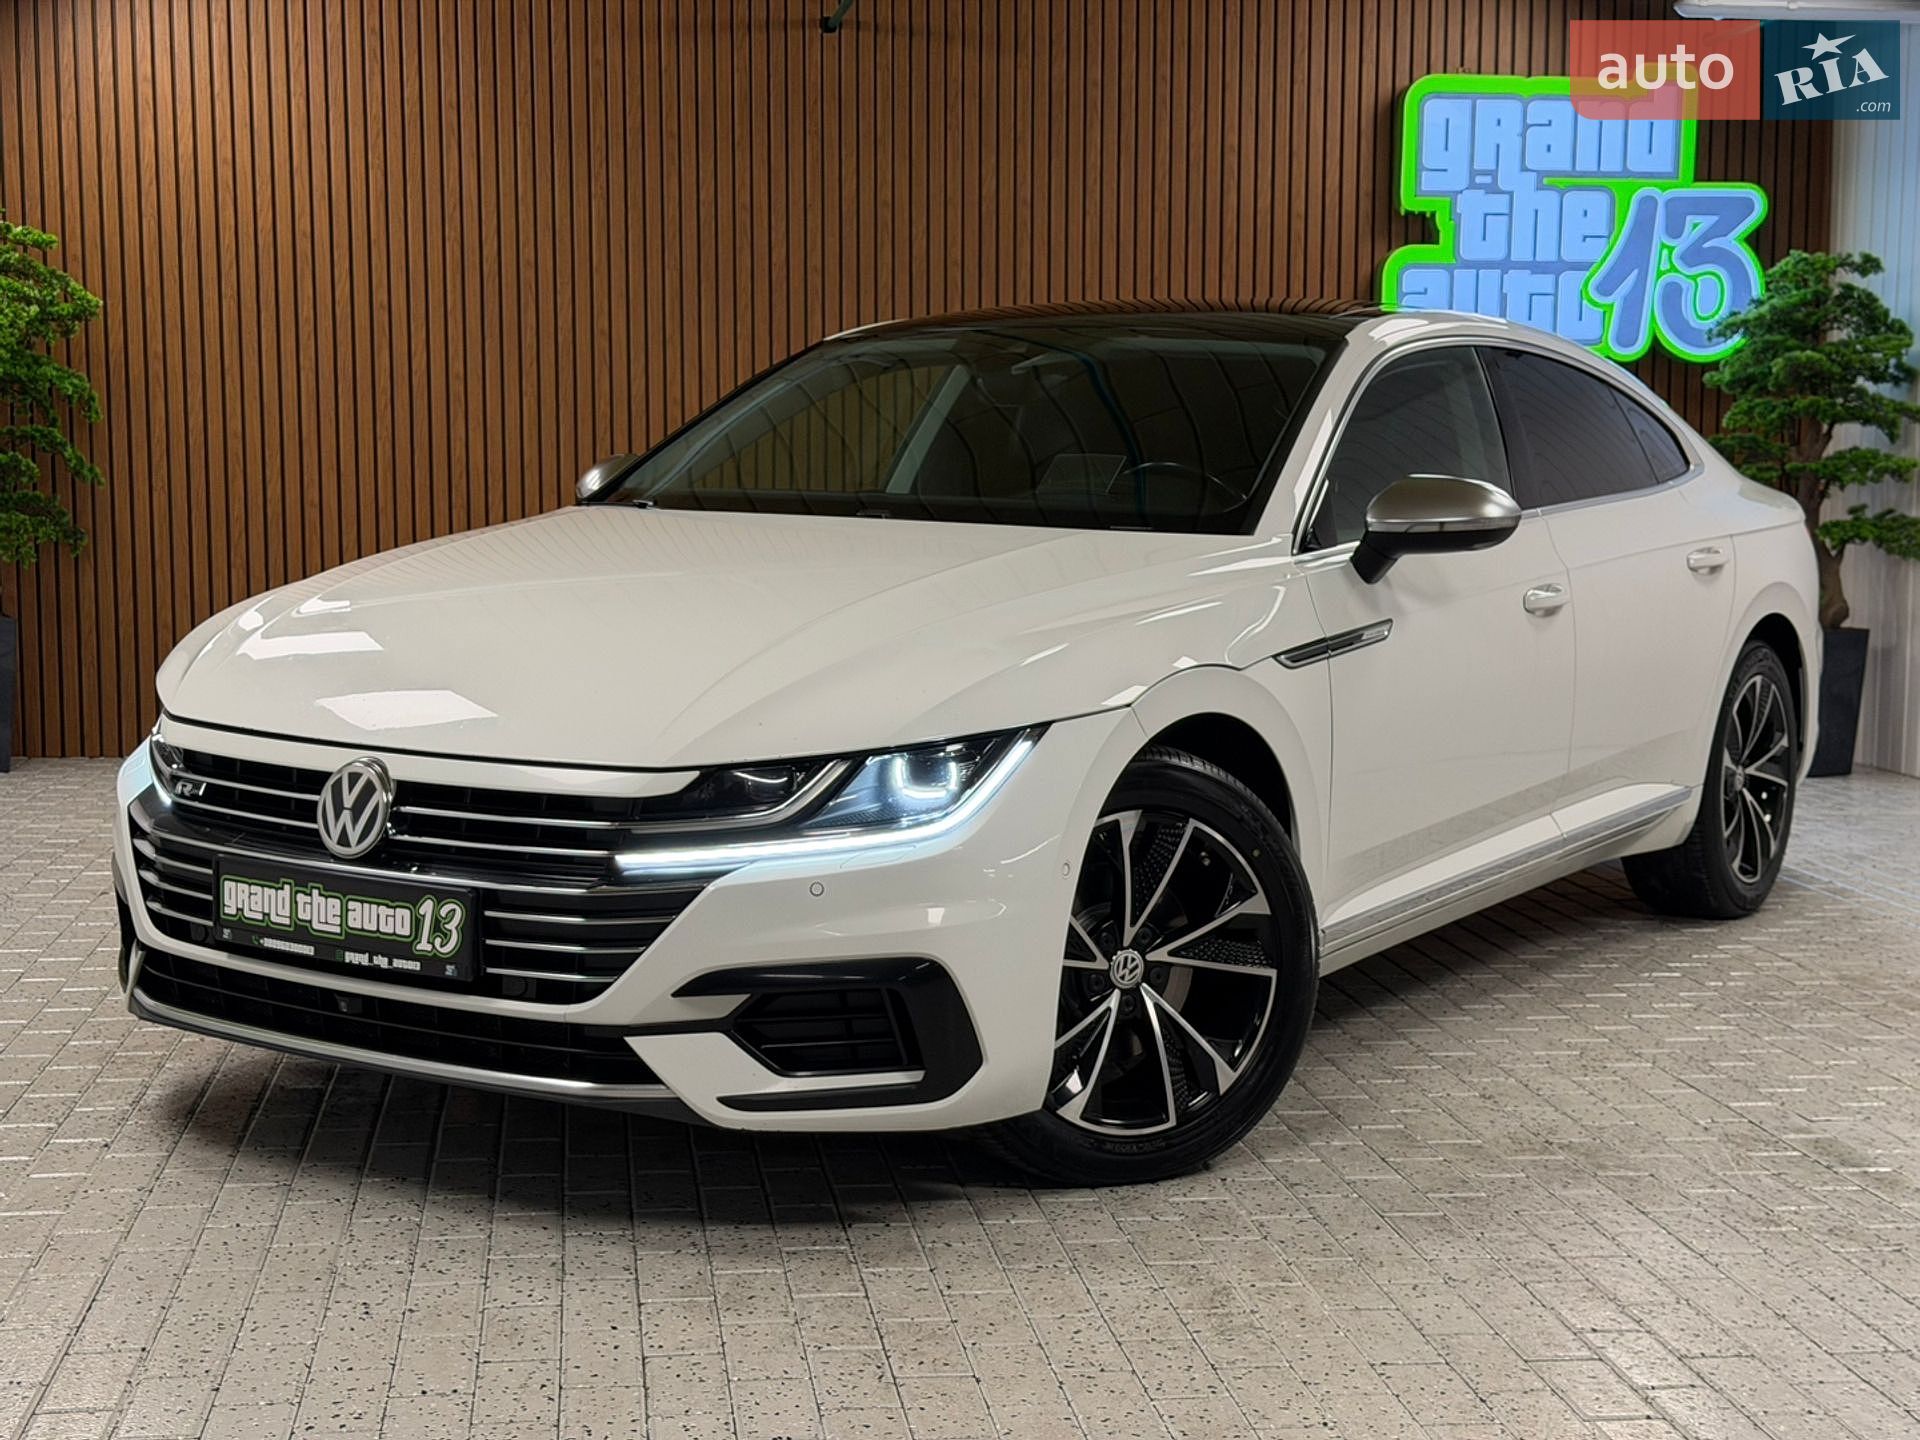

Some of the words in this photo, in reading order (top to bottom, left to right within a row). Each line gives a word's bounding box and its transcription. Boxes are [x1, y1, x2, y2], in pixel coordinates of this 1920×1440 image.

[1421, 85, 1679, 191] grand
[1456, 172, 1611, 263] the
[1589, 187, 1766, 355] 13
[223, 880, 291, 925] grand
[296, 889, 341, 934] the
[347, 901, 411, 936] auto
[415, 899, 462, 953] 13
